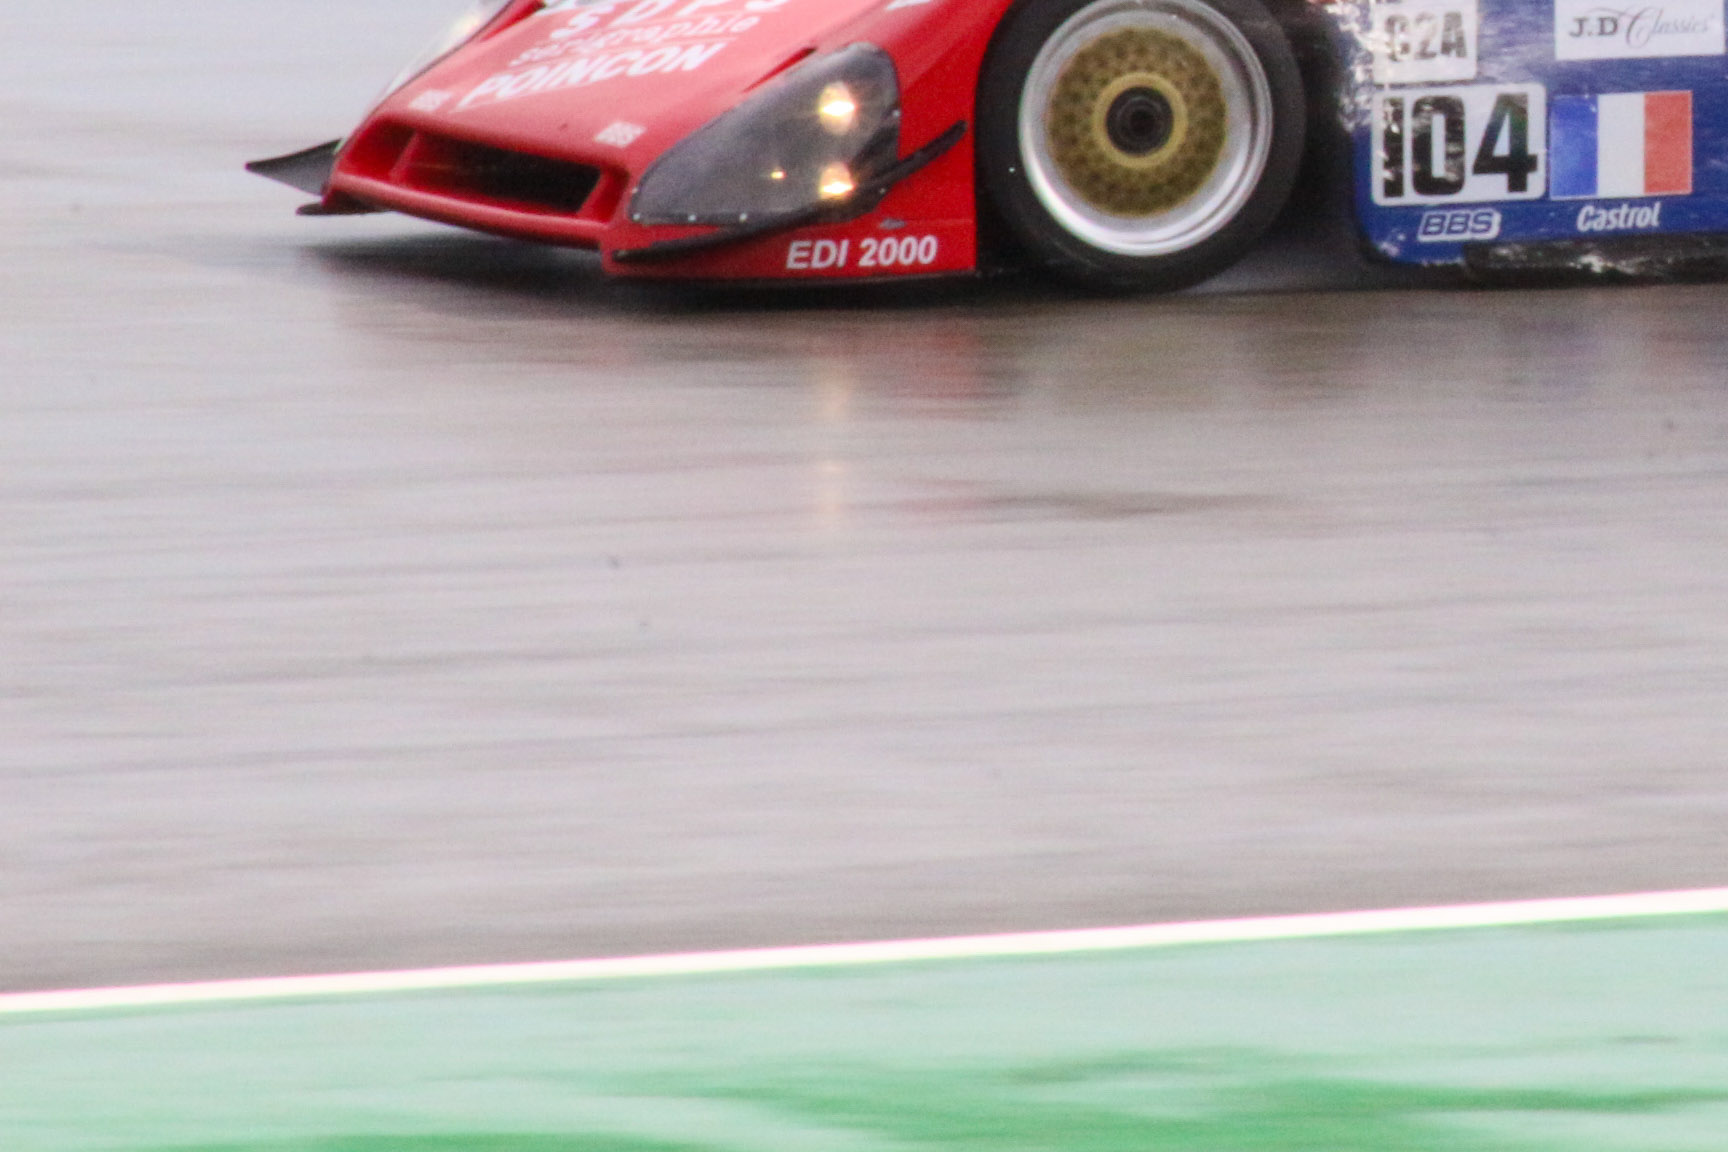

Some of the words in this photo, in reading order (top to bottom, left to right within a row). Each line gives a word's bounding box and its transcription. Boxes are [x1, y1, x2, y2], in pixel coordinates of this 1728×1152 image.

[1383, 92, 1539, 199] 104
[1419, 209, 1499, 239] BBS
[1576, 202, 1661, 233] Castrol
[785, 239, 848, 269] EDI
[858, 235, 938, 267] 2000
